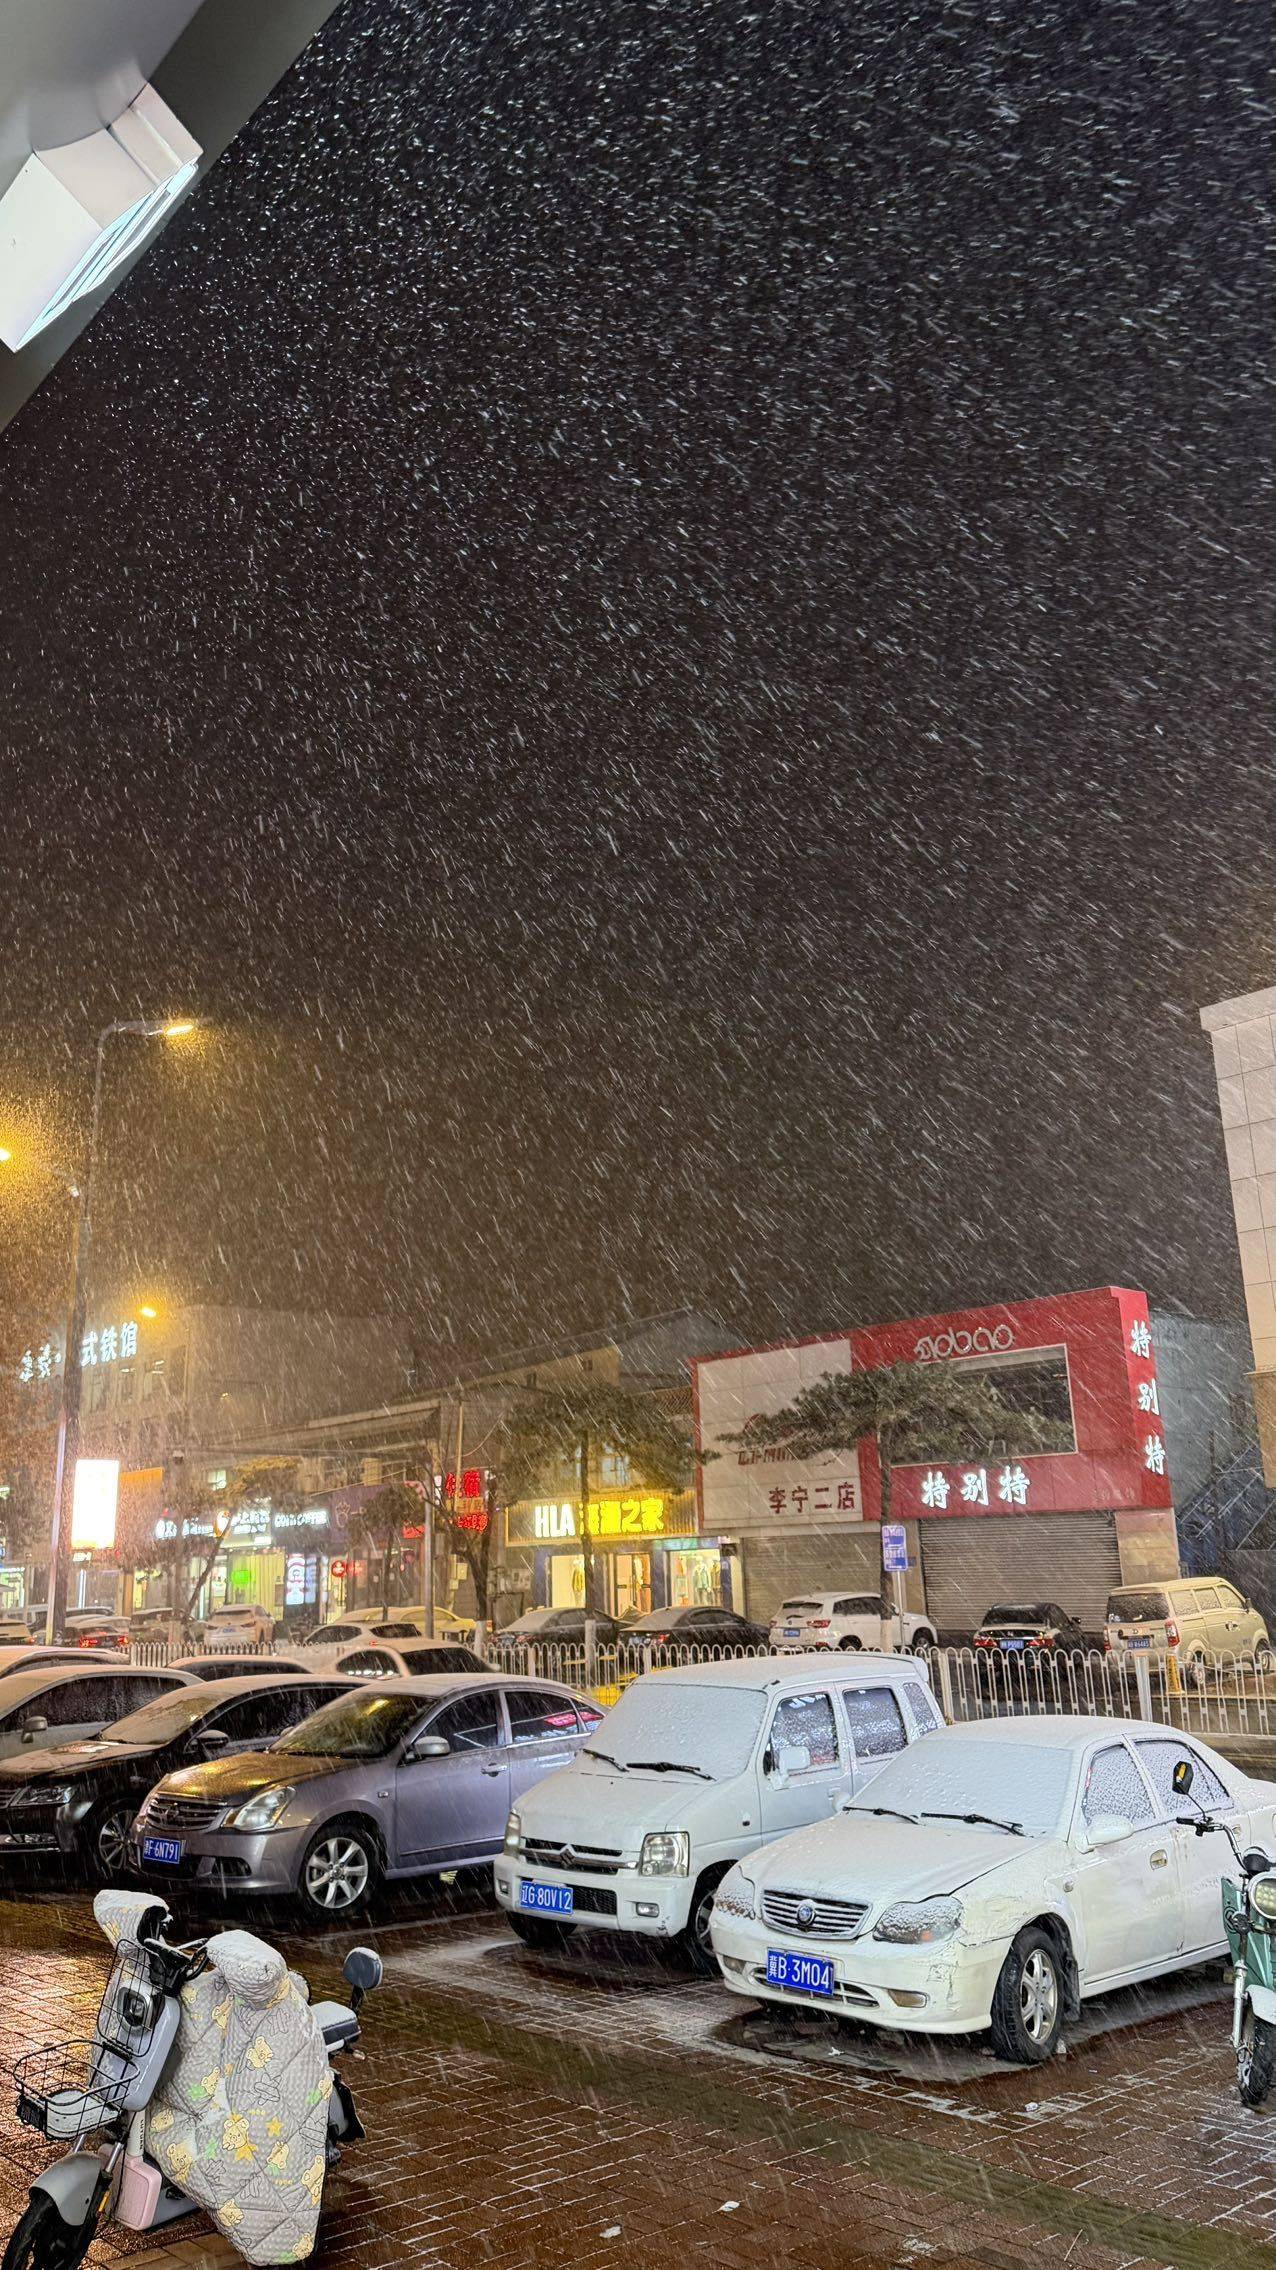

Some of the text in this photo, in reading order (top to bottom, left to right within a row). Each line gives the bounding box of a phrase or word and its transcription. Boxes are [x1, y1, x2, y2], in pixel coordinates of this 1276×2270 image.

[1130, 1319, 1166, 1476] 特别特
[768, 1481, 855, 1515] 李宁二店
[920, 1465, 1031, 1509] 特别特
[535, 1503, 576, 1538] HLA
